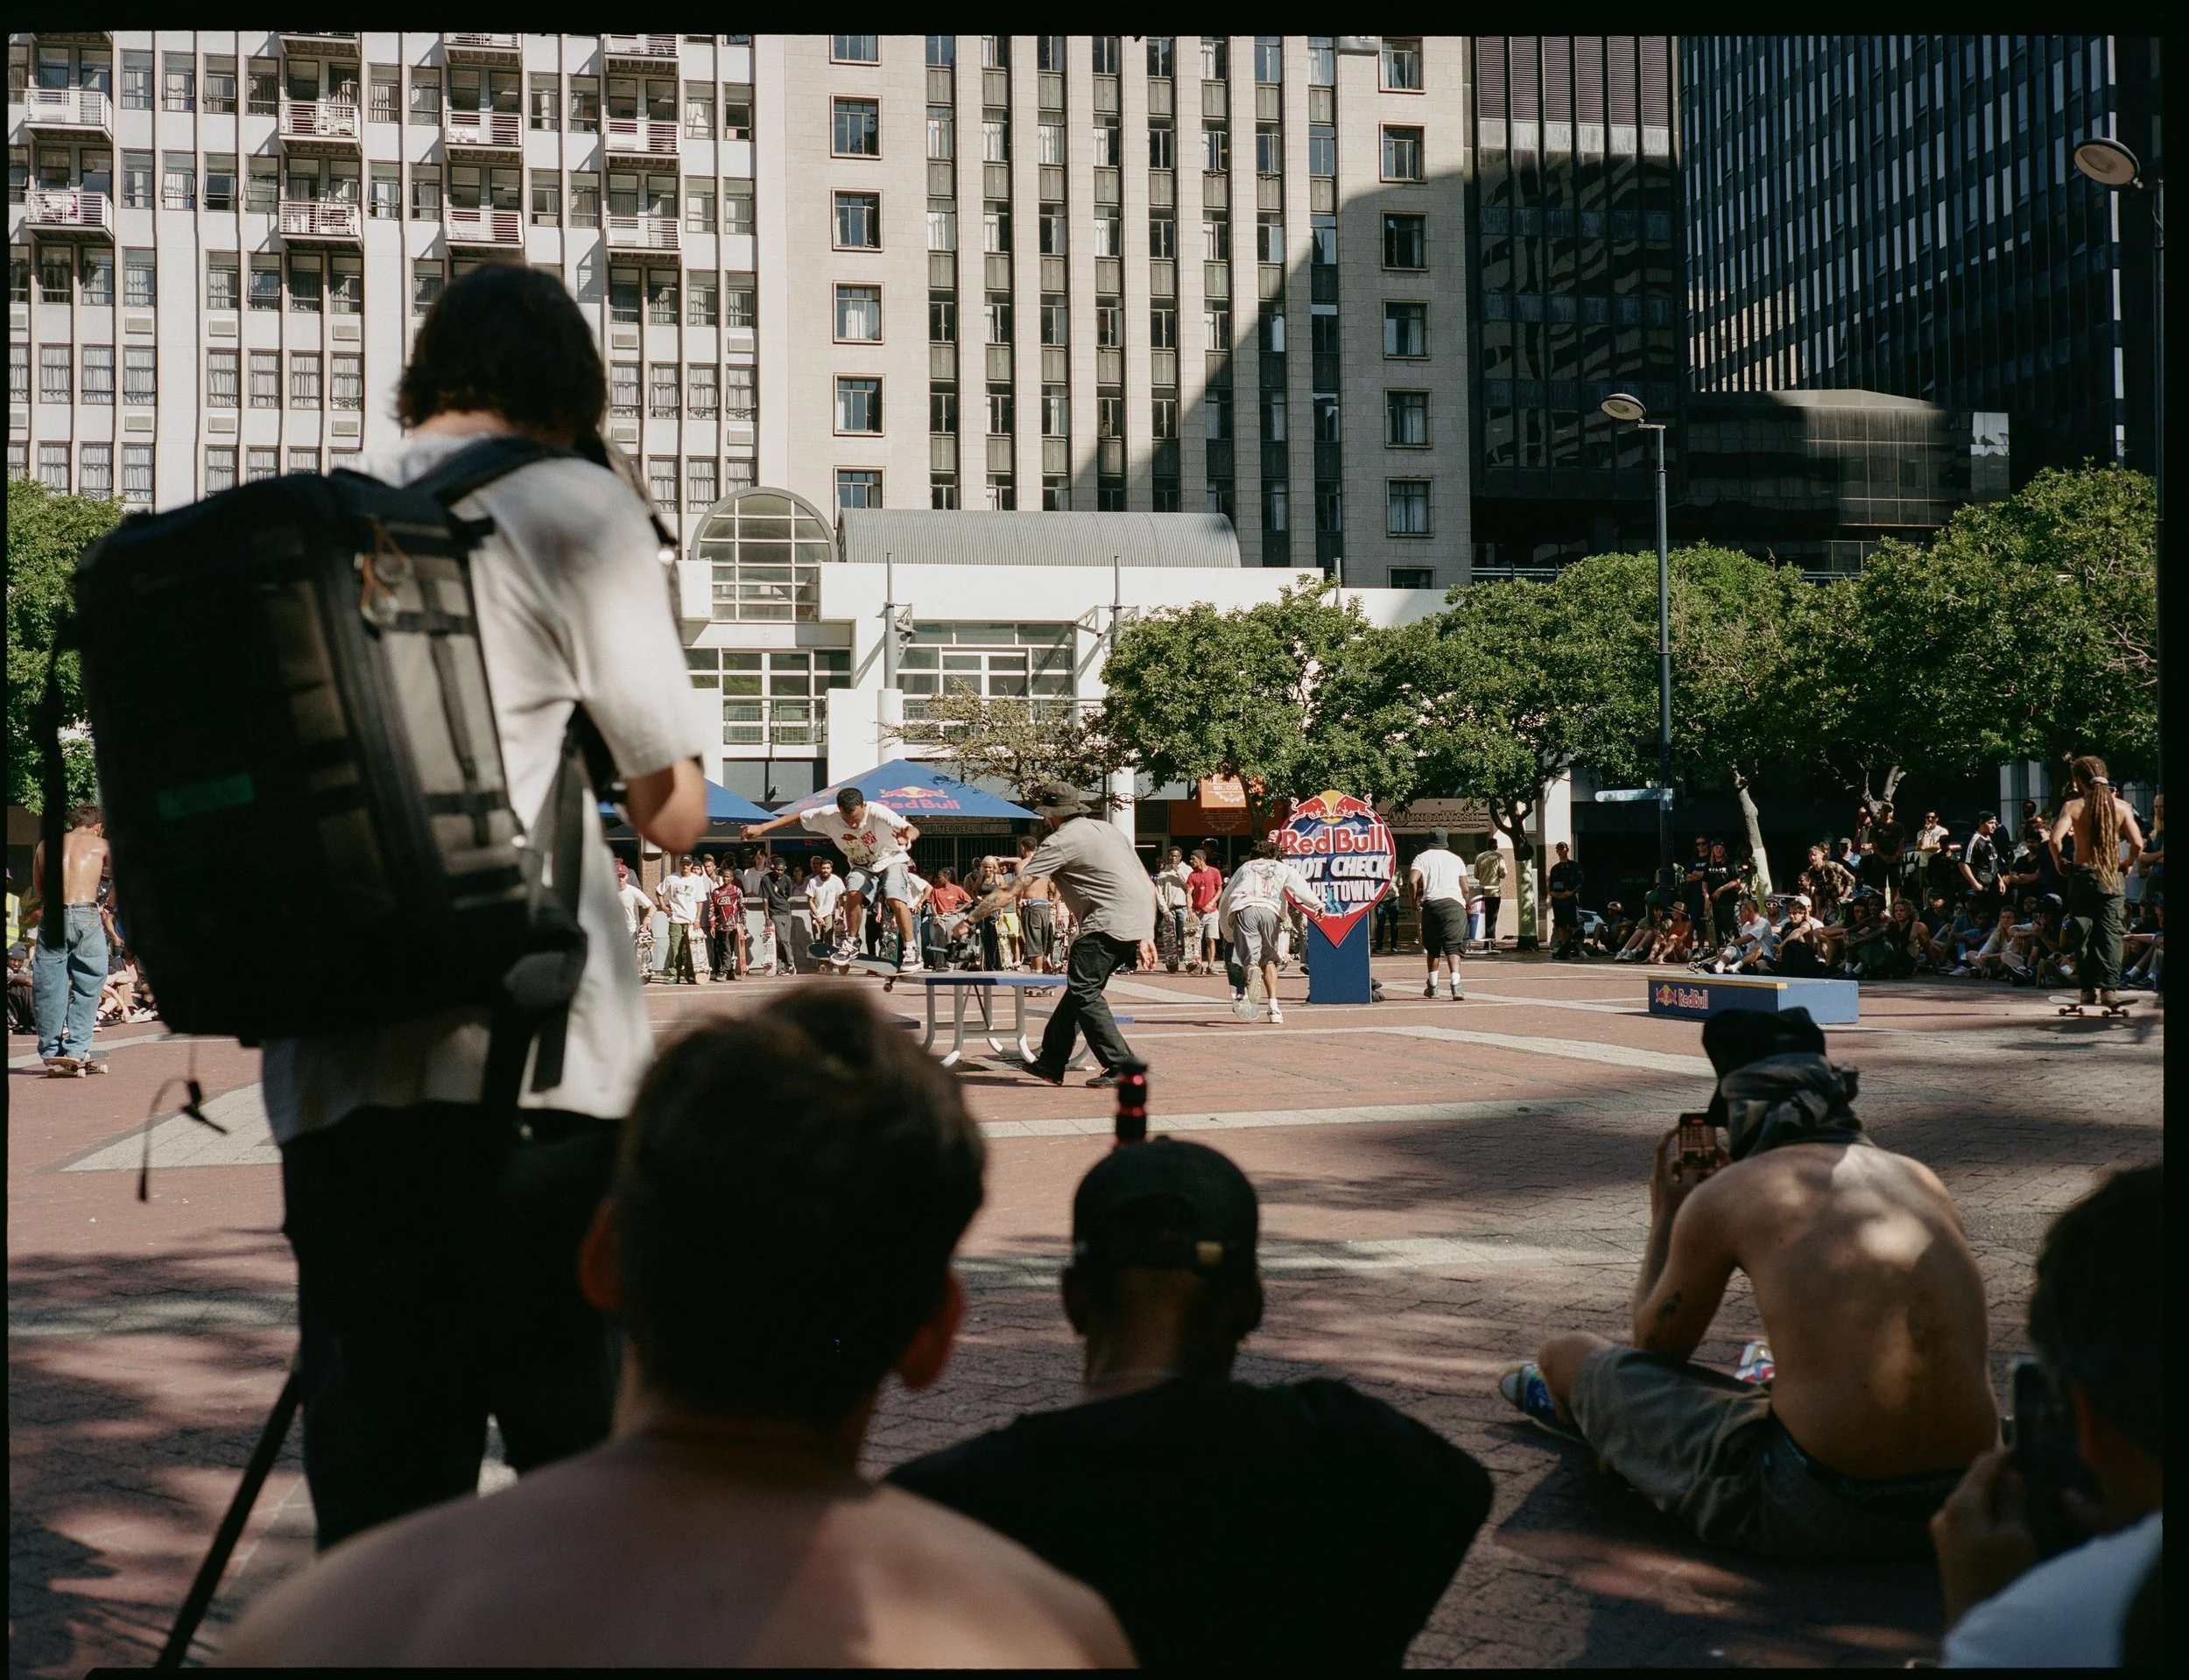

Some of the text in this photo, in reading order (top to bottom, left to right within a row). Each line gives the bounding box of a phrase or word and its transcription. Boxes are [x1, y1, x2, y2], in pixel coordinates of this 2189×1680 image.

[875, 799, 961, 810] Red Bull
[1281, 824, 1385, 854] Red Bull
[1330, 854, 1393, 880] CHECK
[1331, 880, 1376, 901] TOWN
